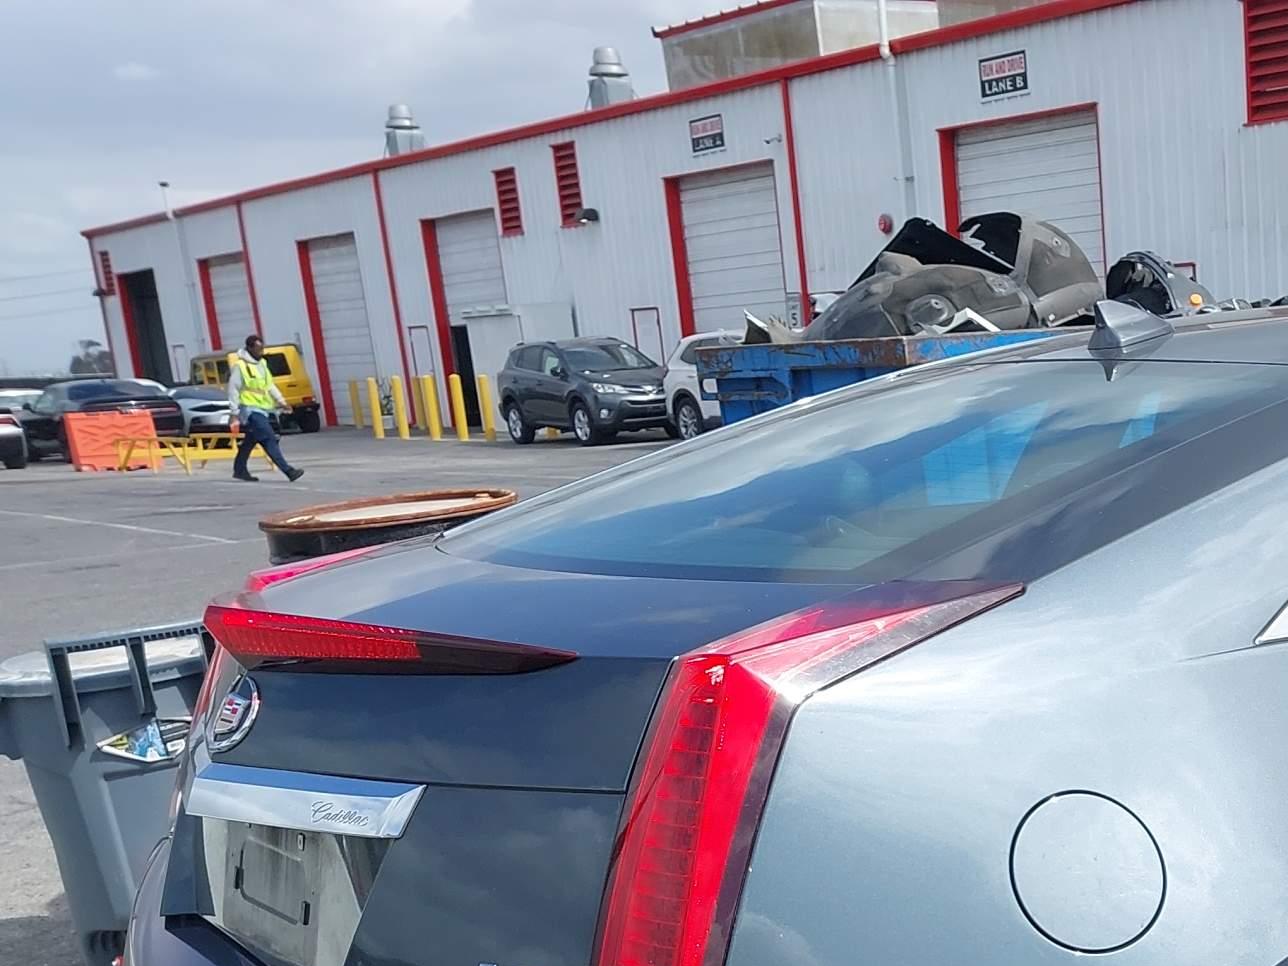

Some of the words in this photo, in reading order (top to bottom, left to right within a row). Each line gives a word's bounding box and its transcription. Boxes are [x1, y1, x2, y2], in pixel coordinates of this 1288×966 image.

[985, 77, 1014, 94] LANE
[1015, 76, 1024, 88] B
[311, 800, 369, 827] Cadillac
